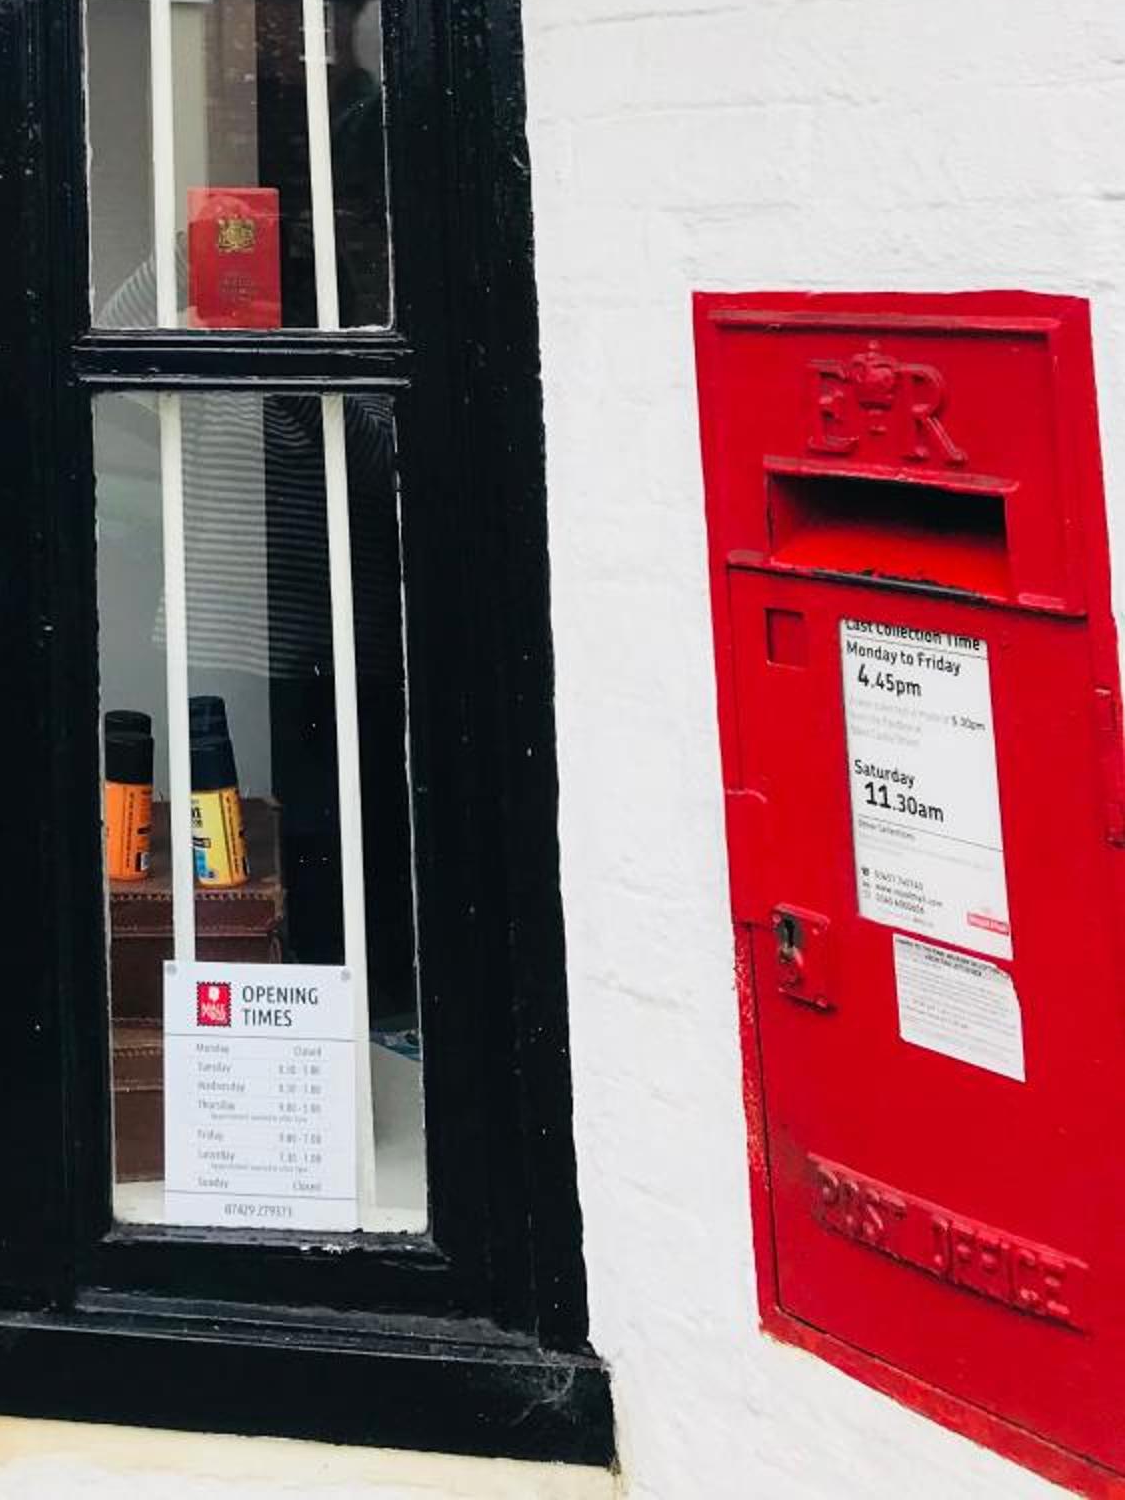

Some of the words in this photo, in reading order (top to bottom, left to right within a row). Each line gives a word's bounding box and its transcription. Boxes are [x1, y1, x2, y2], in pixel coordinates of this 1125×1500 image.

[846, 640, 898, 665] Monday
[900, 651, 914, 665] to
[917, 652, 962, 676] Friday
[857, 664, 922, 697] 4.45pm
[854, 759, 916, 789] Saturday
[864, 781, 944, 822] 11.30am
[242, 985, 319, 1005] OPENING
[242, 1009, 293, 1027] TIMES
